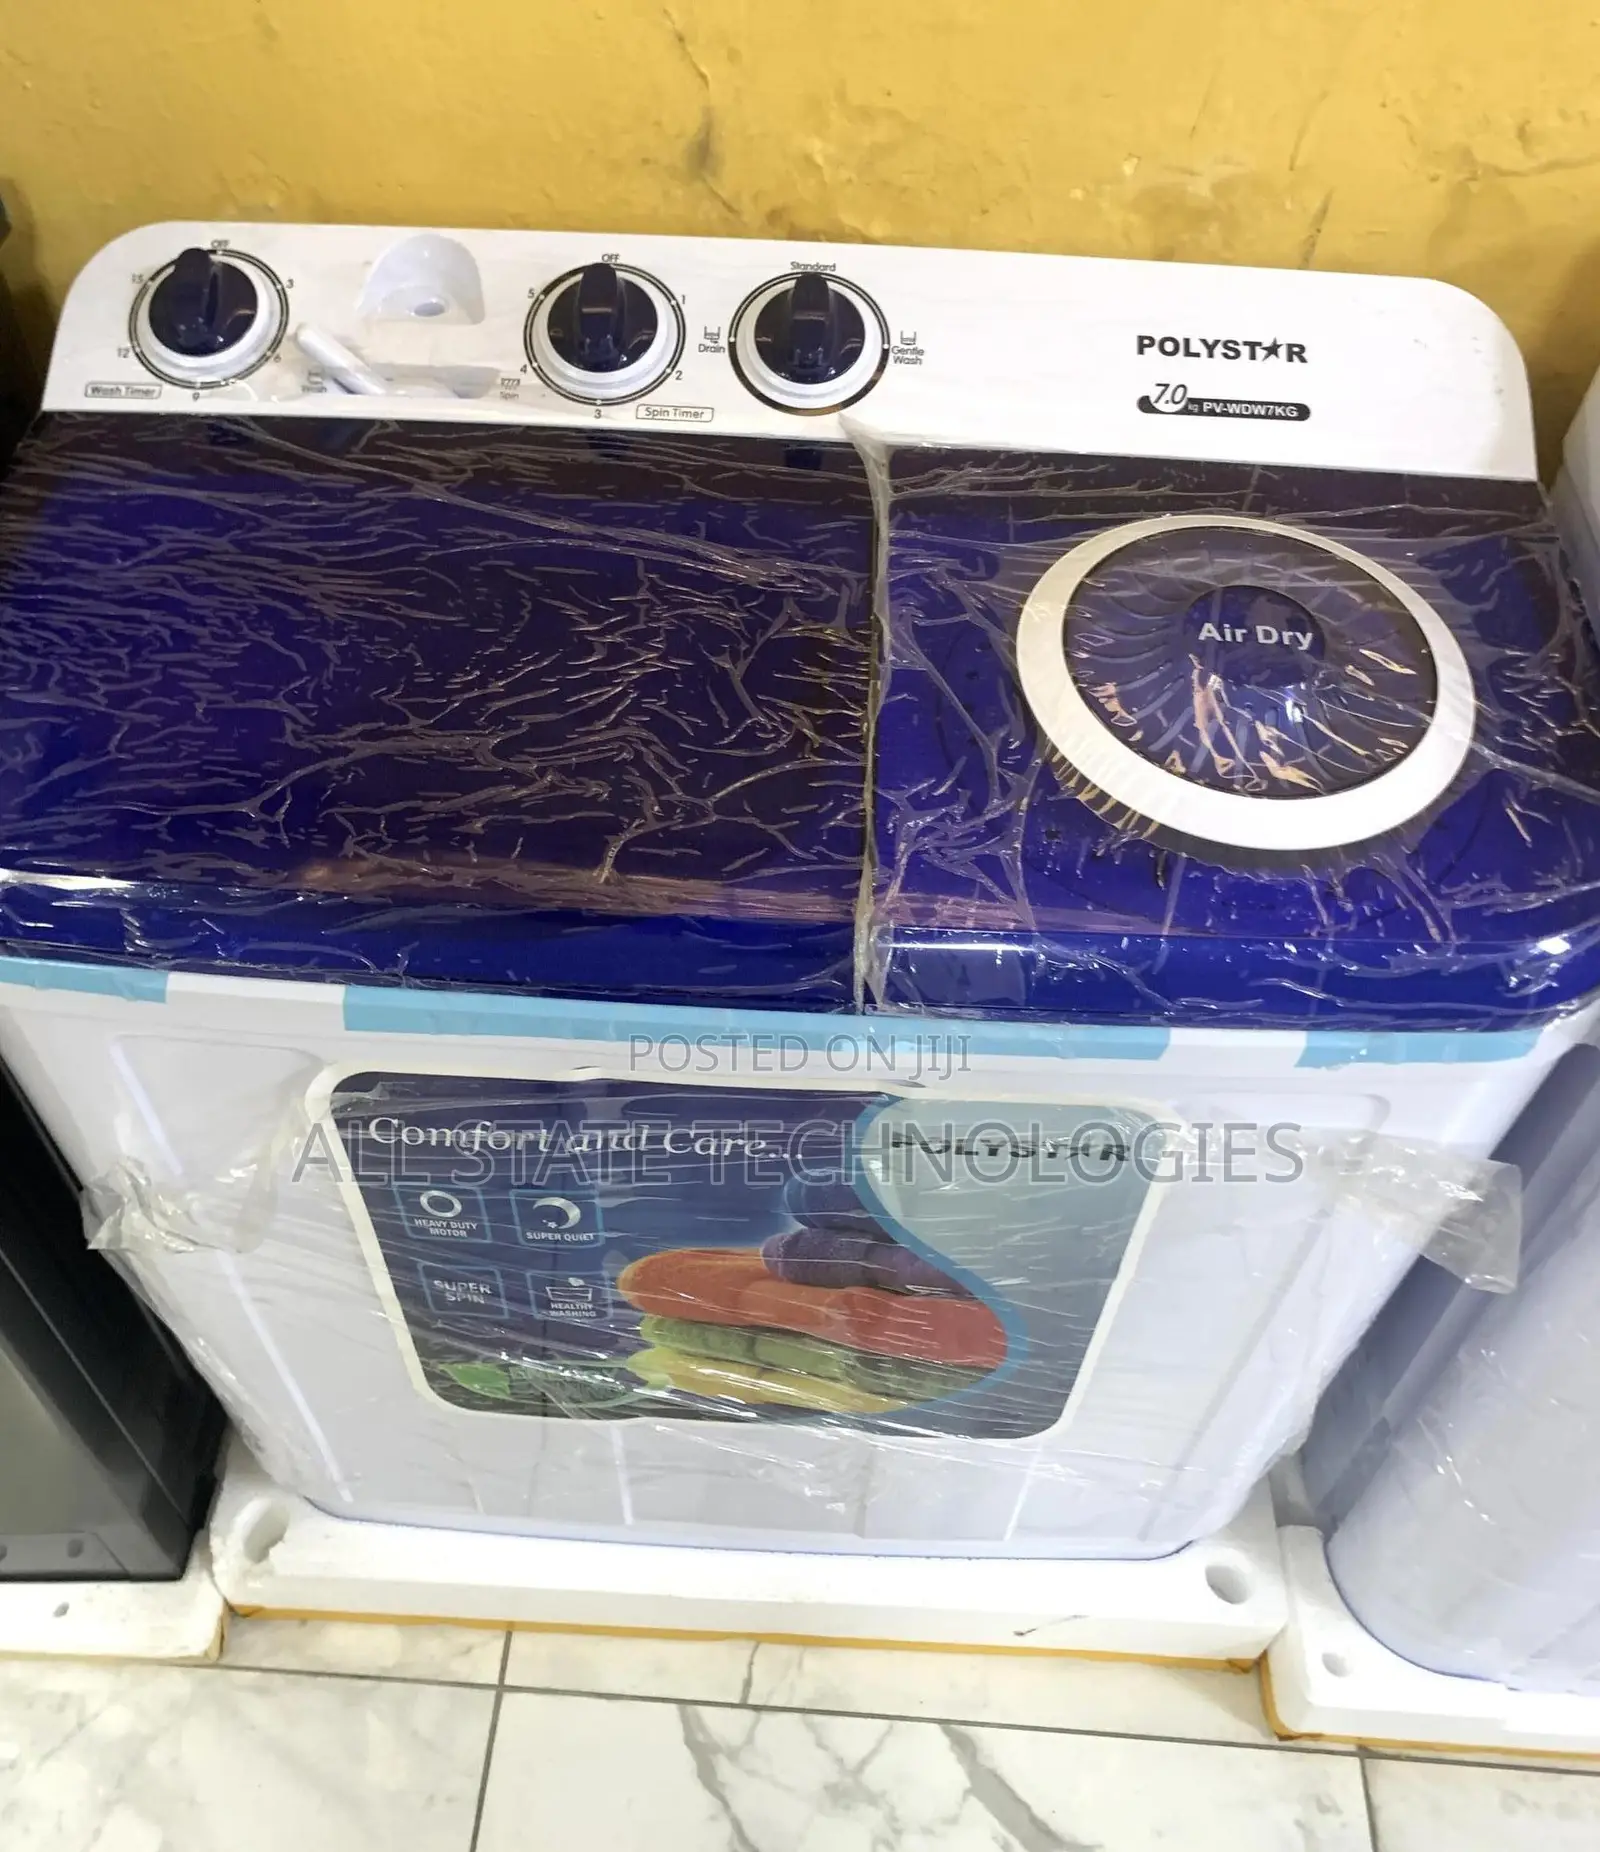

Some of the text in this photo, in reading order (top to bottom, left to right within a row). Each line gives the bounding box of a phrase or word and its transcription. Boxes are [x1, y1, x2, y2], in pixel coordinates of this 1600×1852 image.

[211, 240, 230, 249] OFF
[601, 254, 620, 263] OFF
[790, 261, 837, 272] Standard
[286, 279, 295, 289] 3
[528, 288, 536, 299] 5
[117, 347, 130, 358] 12
[698, 343, 726, 354] Drain
[891, 345, 925, 357] Gentle
[273, 353, 282, 363] 6
[893, 355, 923, 366] Wash
[520, 363, 528, 373] 4
[675, 371, 683, 381] 2
[91, 385, 157, 397] Wash Timer
[192, 391, 201, 402] 9
[1153, 383, 1188, 406] 7.0
[1202, 401, 1299, 418] PV-WDW7KG
[594, 409, 602, 419] 3
[644, 407, 705, 419] Spin Timer
[1198, 622, 1313, 651] Air Dry
[368, 1117, 549, 1154] Comfort
[564, 1124, 650, 1153] and
[414, 1218, 478, 1231] HEAVY DUTY
[429, 1227, 468, 1238] MOTOR
[526, 1231, 596, 1242] SUPER QUIET
[433, 1279, 493, 1295] SUPER
[446, 1292, 486, 1305] SPIN
[551, 1302, 594, 1311] HEALTHY
[549, 1309, 597, 1318] WASHING
